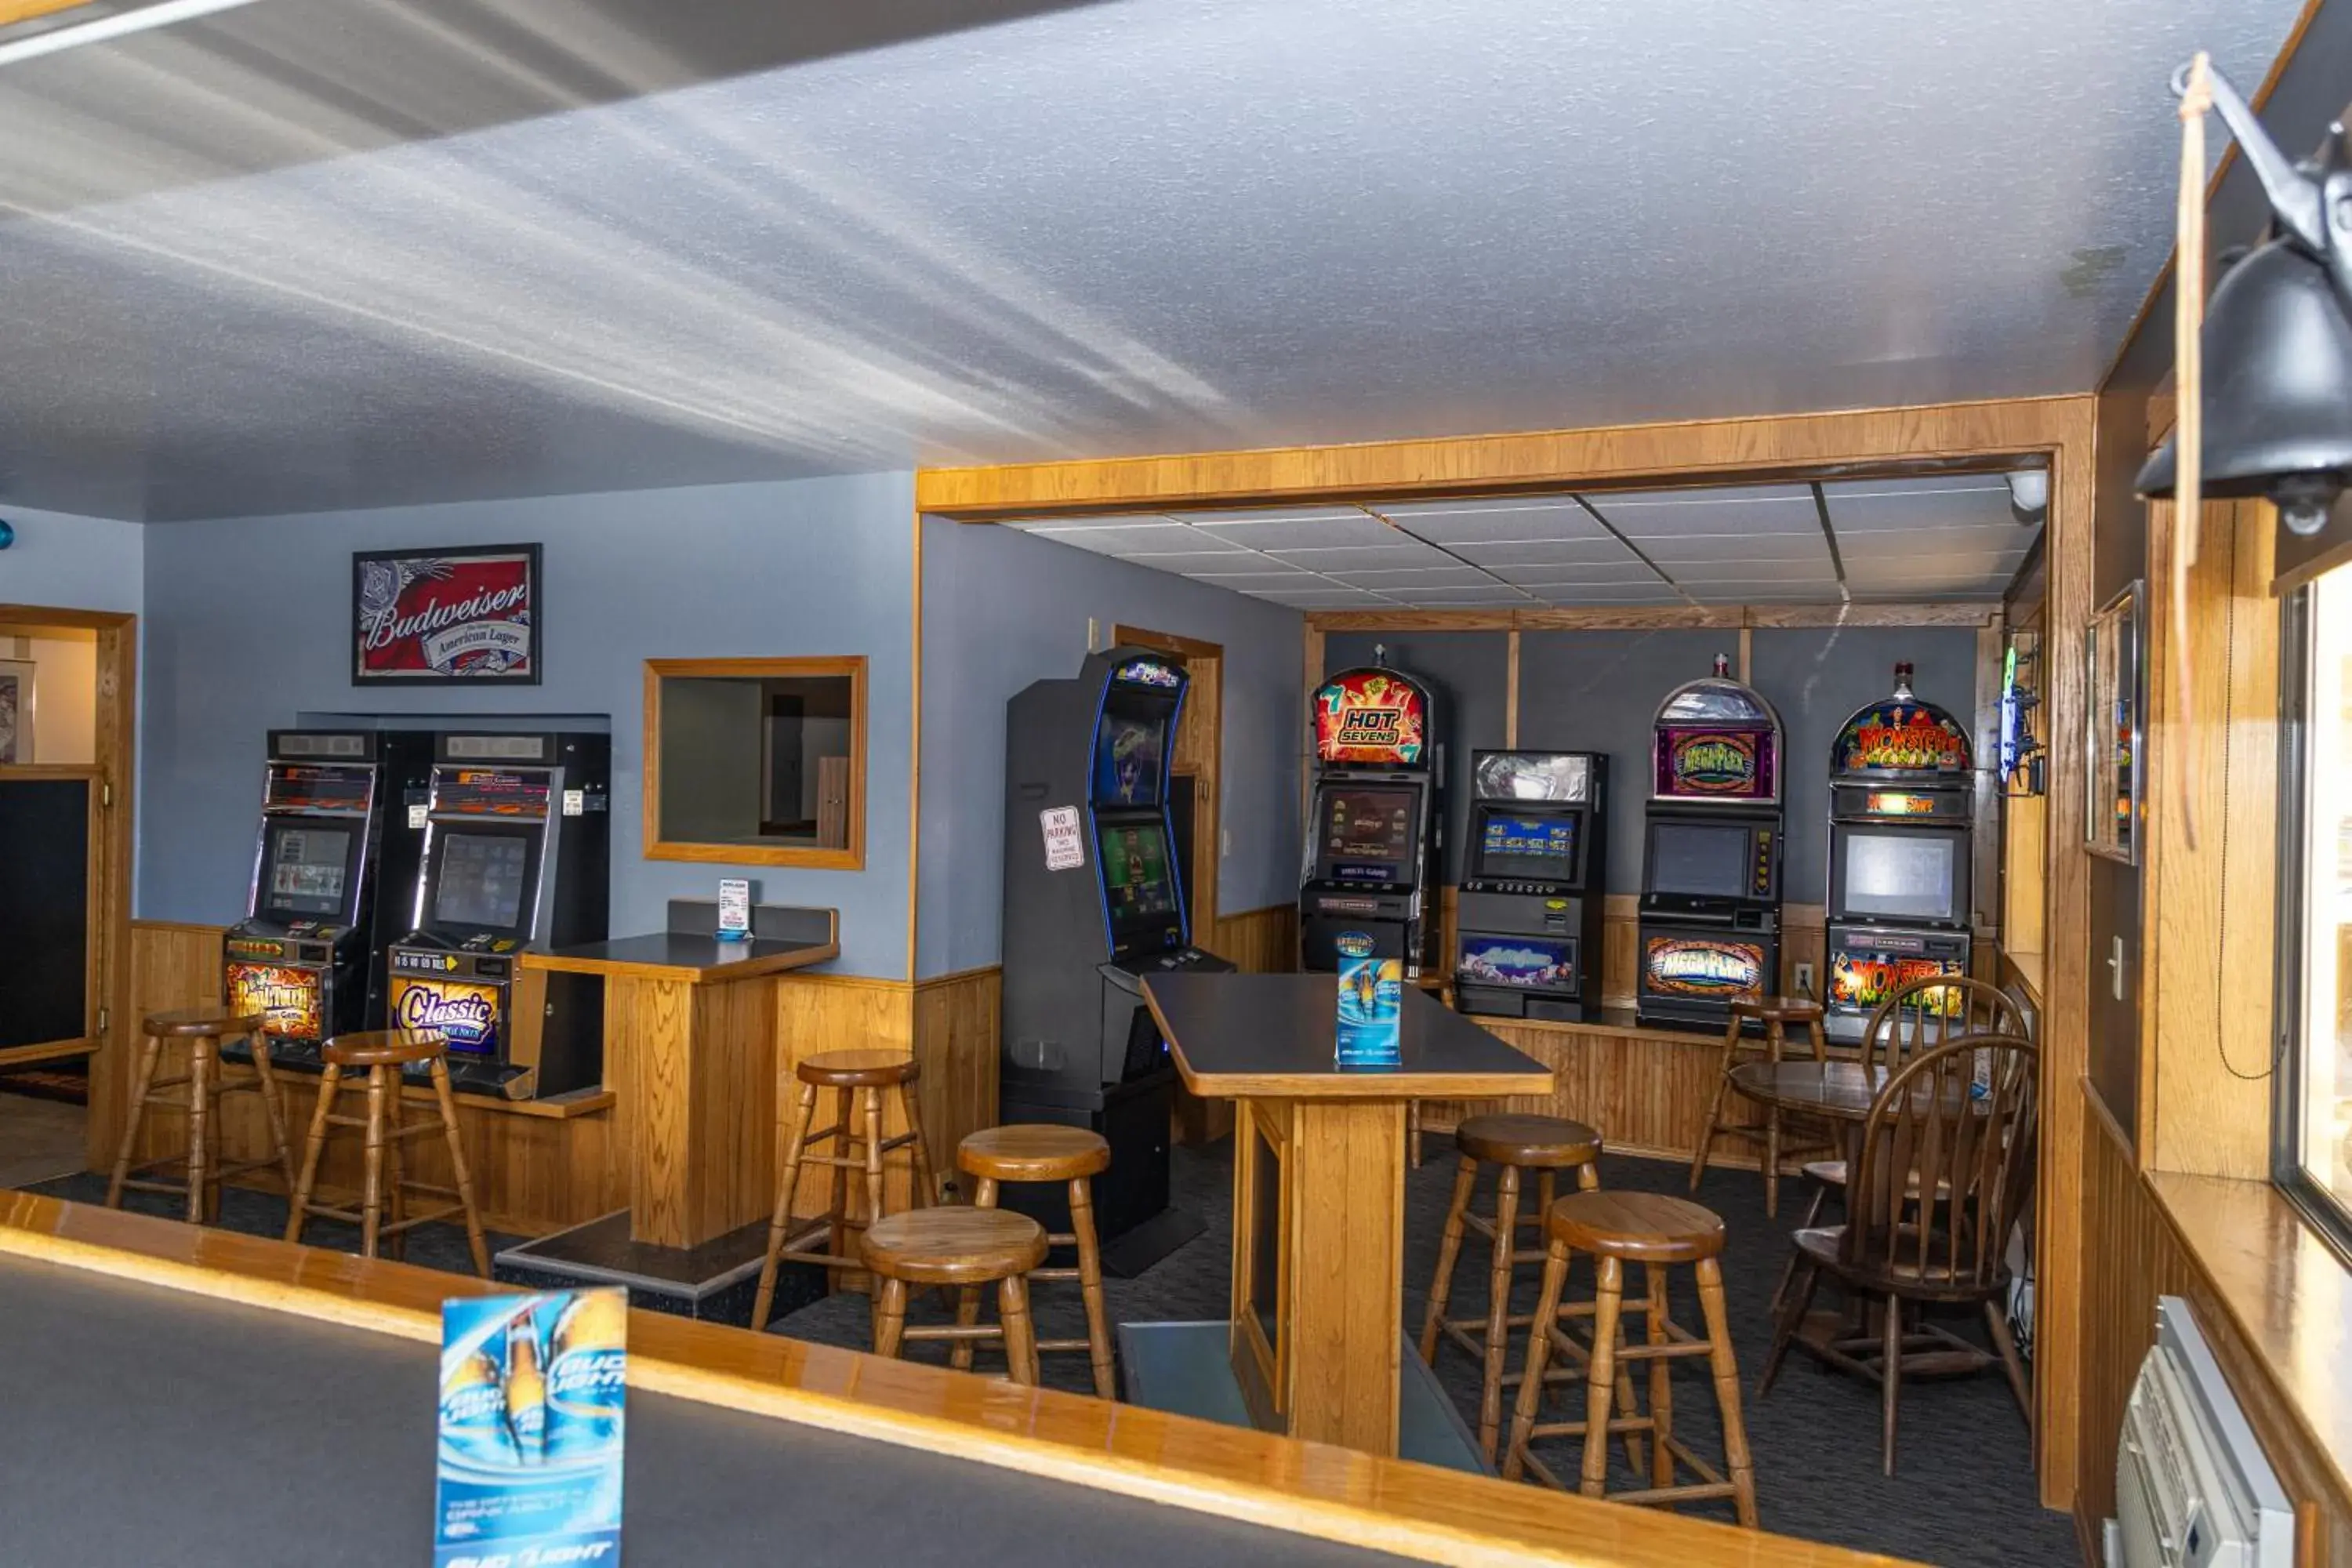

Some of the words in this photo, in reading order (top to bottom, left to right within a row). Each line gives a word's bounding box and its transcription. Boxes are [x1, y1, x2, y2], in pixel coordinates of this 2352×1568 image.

[364, 584, 526, 651] Budweiser
[438, 628, 487, 653] American
[489, 629, 521, 647] Lager
[1348, 712, 1397, 729] HOT
[1341, 731, 1396, 742] SEVENS
[1053, 814, 1066, 825] NO
[400, 988, 489, 1029] Classic
[559, 1355, 626, 1376] BUD
[530, 1540, 614, 1565] LIGHT
